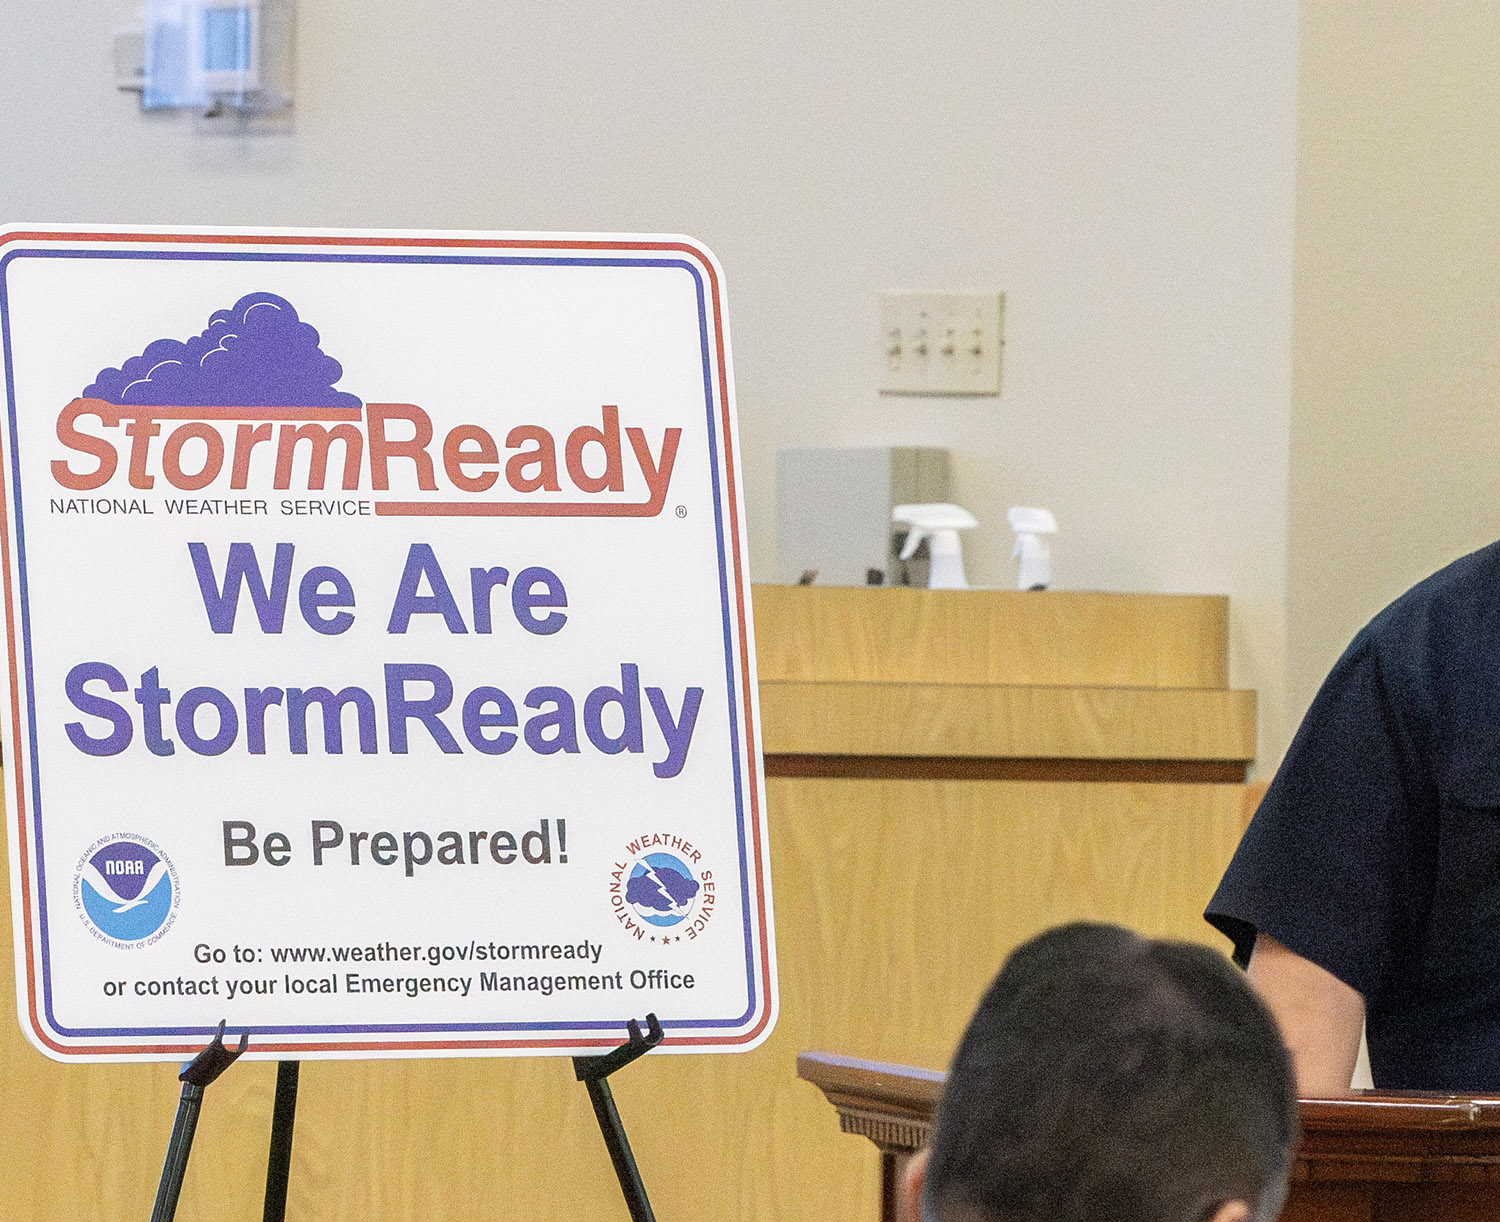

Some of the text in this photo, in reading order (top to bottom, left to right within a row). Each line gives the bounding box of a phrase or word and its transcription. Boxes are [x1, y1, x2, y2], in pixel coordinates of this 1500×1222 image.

[50, 397, 682, 517] StormReady
[50, 498, 371, 516] NATIONAL WEATHER SERVICE
[188, 542, 568, 635] We Are
[64, 662, 705, 779] StormReady
[106, 860, 145, 875] NOAA
[222, 818, 568, 877] Be Prepared!
[609, 833, 715, 941] NATIONAL WEATHER SERVICE
[194, 940, 603, 967] Go to: www.weather.gov/stormready
[103, 969, 695, 1000] or contact your local Emergency Management Office
